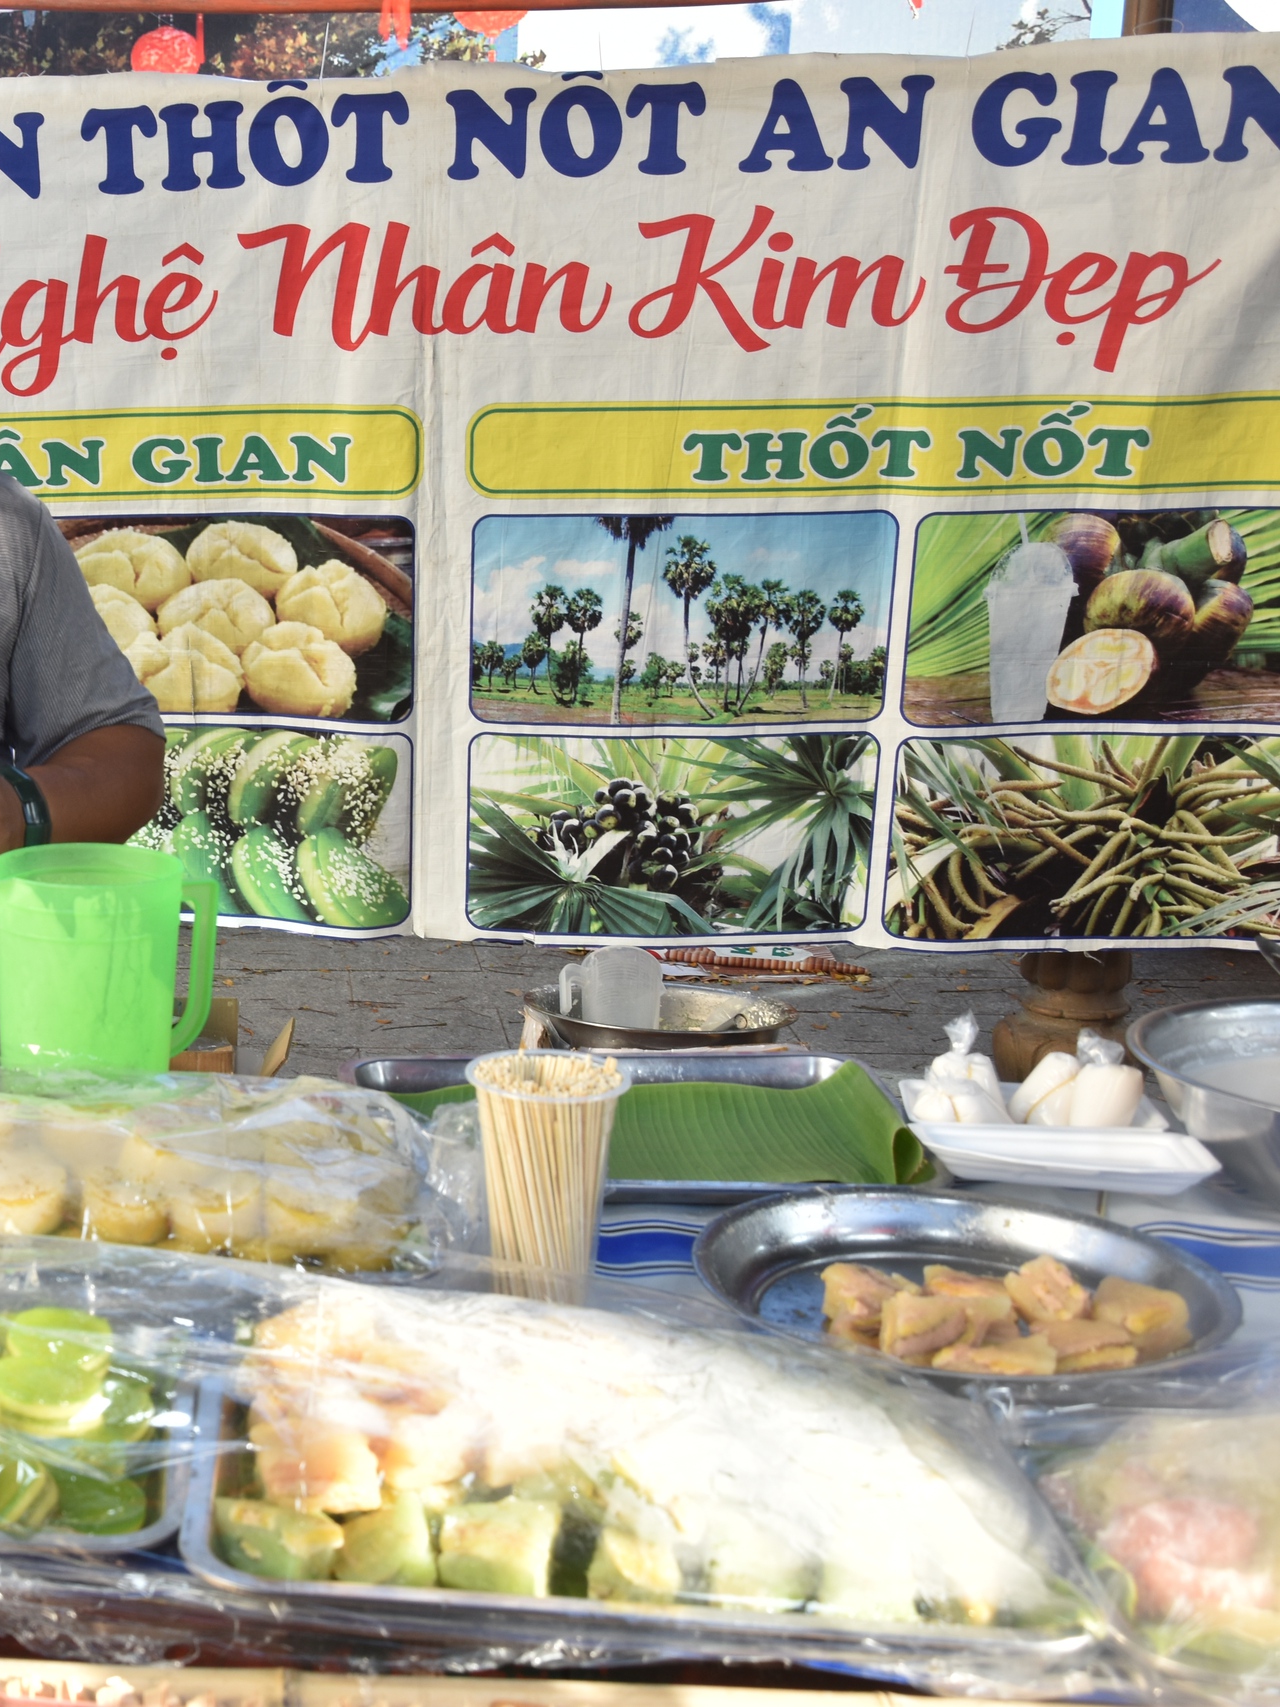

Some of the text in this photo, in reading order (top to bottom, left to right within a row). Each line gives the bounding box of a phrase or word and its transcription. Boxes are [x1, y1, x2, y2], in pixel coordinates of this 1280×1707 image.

[739, 76, 934, 172] AN
[972, 67, 1280, 167] GIAN
[238, 222, 612, 351] Nhân
[628, 205, 926, 352] Kim
[945, 207, 1222, 372] Đẹp
[132, 434, 350, 483] GIAN
[685, 404, 1149, 480] THỐT NỐT
